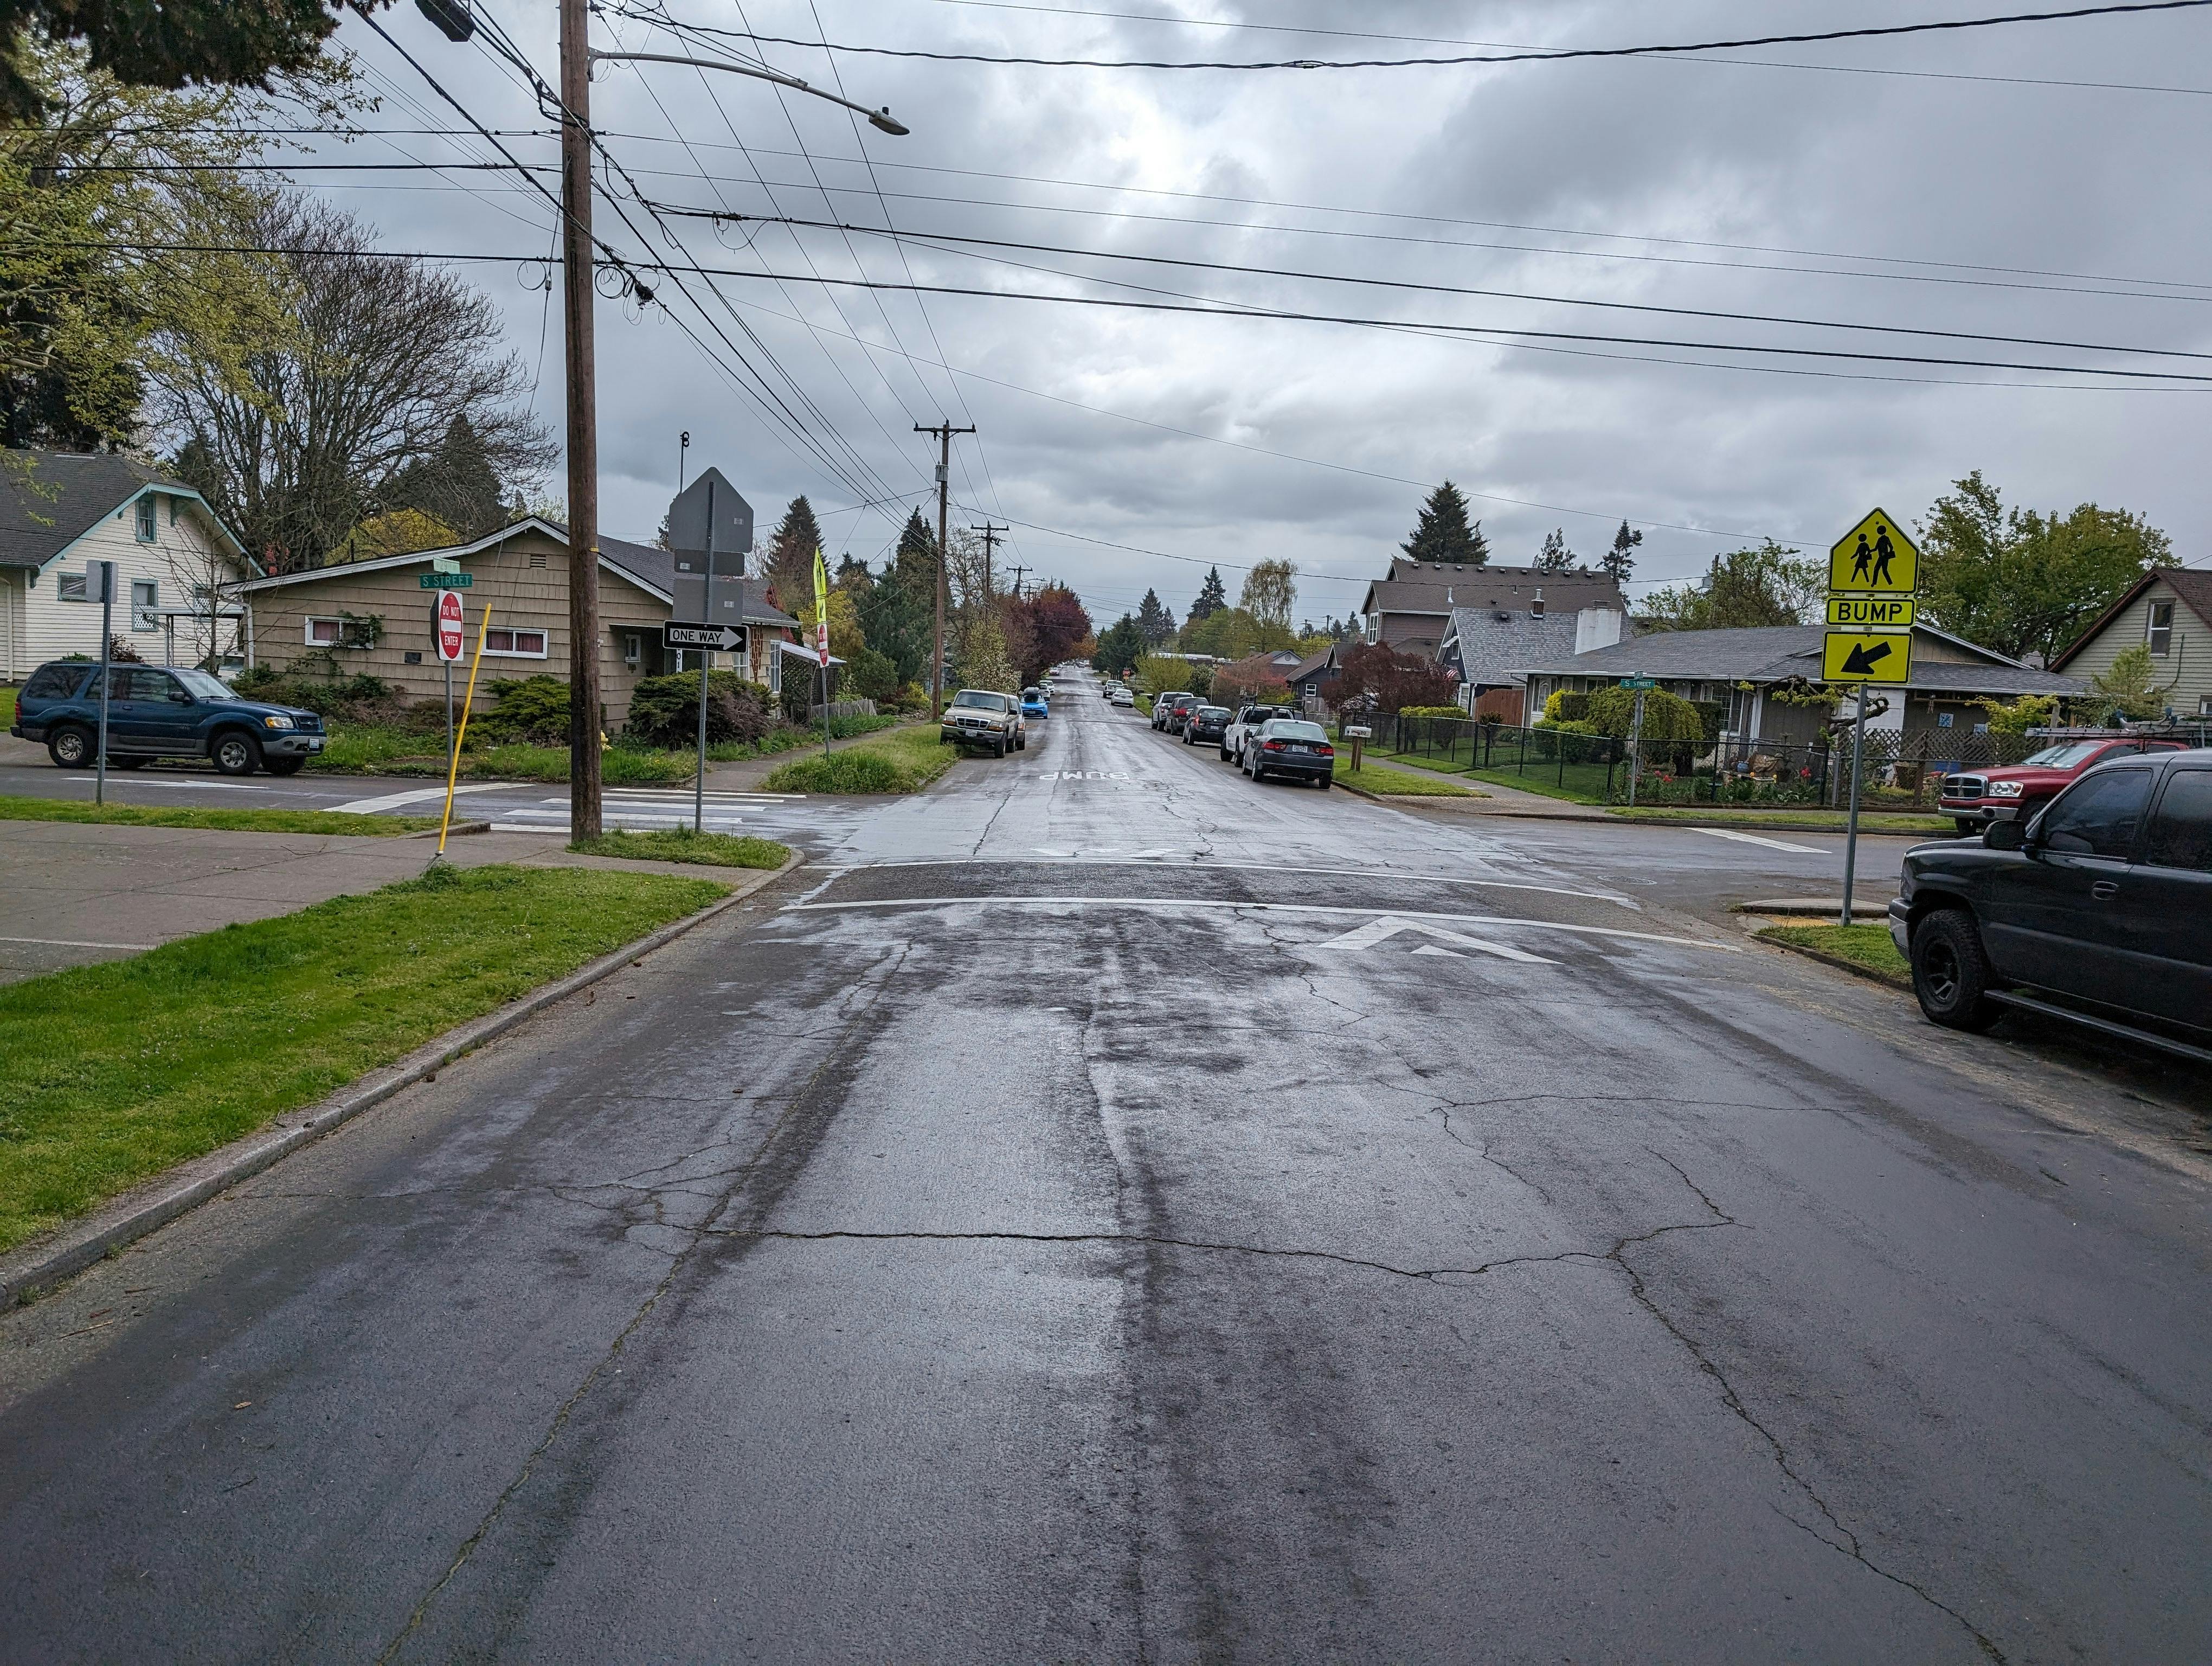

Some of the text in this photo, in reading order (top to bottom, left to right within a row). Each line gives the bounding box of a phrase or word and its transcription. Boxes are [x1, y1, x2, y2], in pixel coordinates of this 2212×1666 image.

[423, 575, 471, 587] S STREET
[442, 605, 459, 617] DO NOT
[1838, 603, 1902, 621] BUMP
[445, 635, 459, 646] ENTER
[673, 630, 722, 643] ONE WAY
[1039, 771, 1129, 780] BUMP
